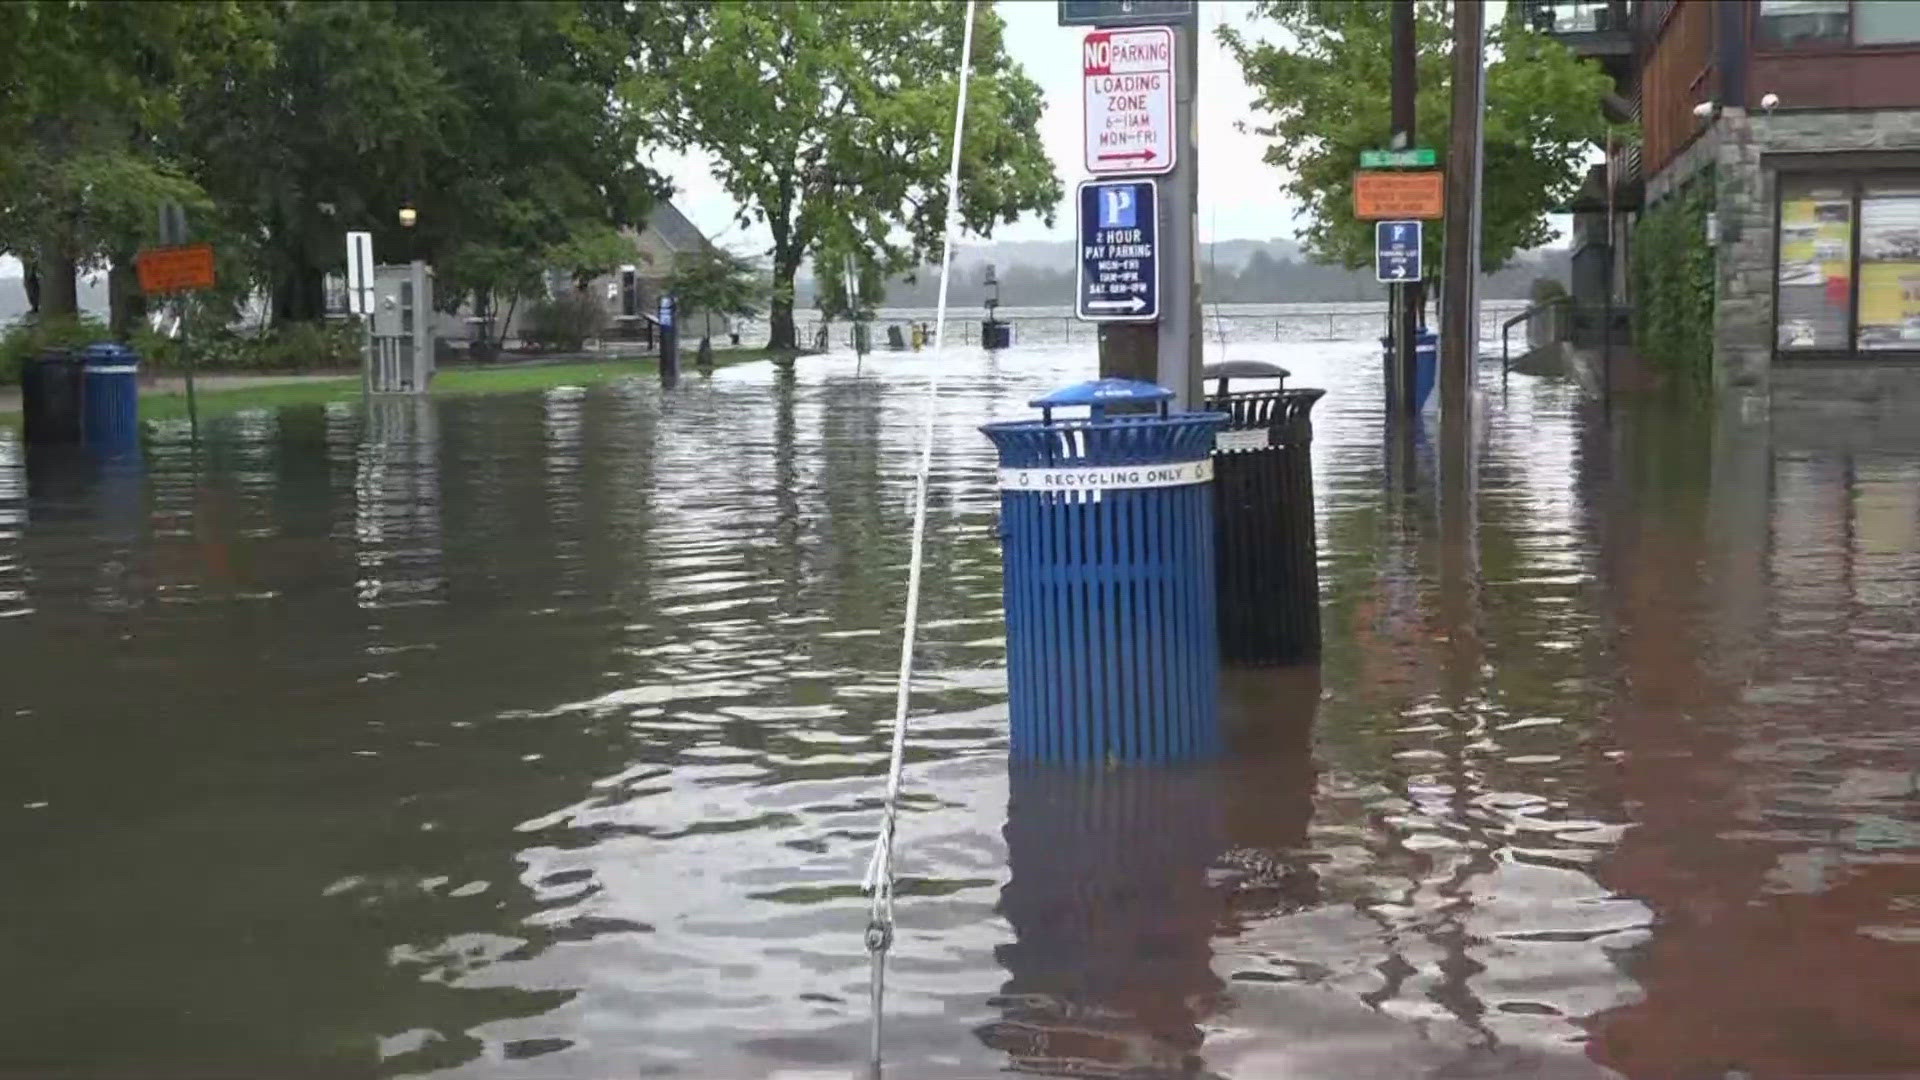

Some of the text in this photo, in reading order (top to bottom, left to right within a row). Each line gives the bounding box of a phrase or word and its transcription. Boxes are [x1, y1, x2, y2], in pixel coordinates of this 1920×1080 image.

[1085, 42, 1168, 69] NO PARKING
[1094, 77, 1161, 94] LOADING
[1107, 95, 1147, 112] ZONE
[1100, 131, 1158, 147] MON-FRI
[1107, 190, 1131, 224] P
[1096, 229, 1142, 244] 2 HOUR
[1085, 244, 1152, 259] PAY PARKING
[1099, 260, 1139, 270] MON-FRI
[1045, 470, 1183, 486] RECYCLING ONLY
